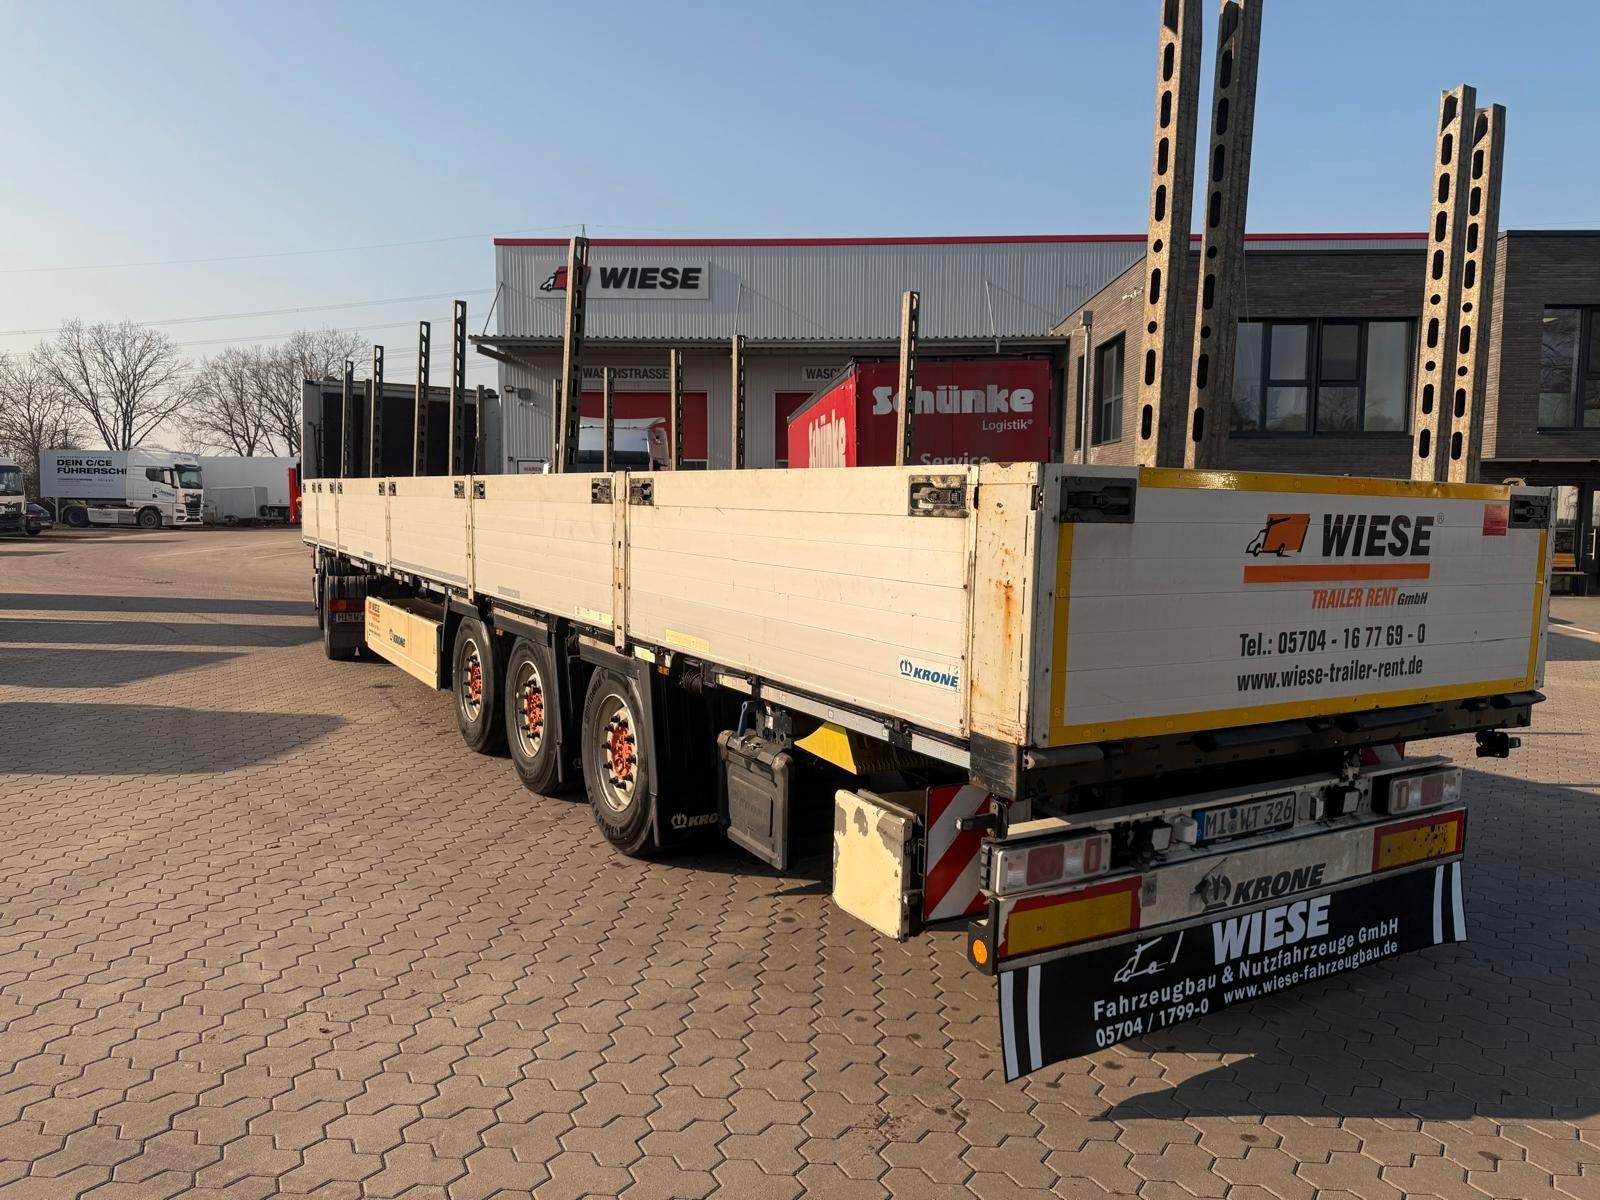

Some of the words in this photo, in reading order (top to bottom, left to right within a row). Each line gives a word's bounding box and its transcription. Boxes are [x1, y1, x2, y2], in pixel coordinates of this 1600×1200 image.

[599, 267, 702, 289] WIESE
[583, 367, 669, 379] WASHSTRASSE
[1322, 514, 1434, 557] WIESE
[1311, 588, 1362, 609] TRAILER
[1365, 587, 1398, 607] RENT
[1397, 592, 1428, 606] GmbH
[1239, 633, 1272, 657] Tel.:
[1278, 628, 1326, 655] 05704
[1343, 627, 1360, 650] 16
[1364, 626, 1383, 648] 77
[1386, 625, 1404, 647] 69
[1417, 623, 1426, 645] 0
[913, 667, 959, 687] KRONE
[1237, 655, 1423, 691] www.wiese-trailer-rent.de
[688, 813, 718, 827] KRO
[1205, 812, 1226, 837] MI
[1263, 799, 1293, 826] 326
[1234, 863, 1326, 904] KRONE
[1212, 896, 1330, 965] WIESE
[1094, 974, 1216, 1021] Fahrzeugbau
[1223, 966, 1234, 983] &
[1239, 933, 1354, 979] Nutzfahrzeuge
[1359, 918, 1399, 941] GmbH
[1224, 940, 1398, 1004] www.wiese-fahrzeugbau.de
[1096, 1017, 1143, 1048] 05704
[1148, 1013, 1155, 1032] /
[1159, 998, 1209, 1027] 1799-0
